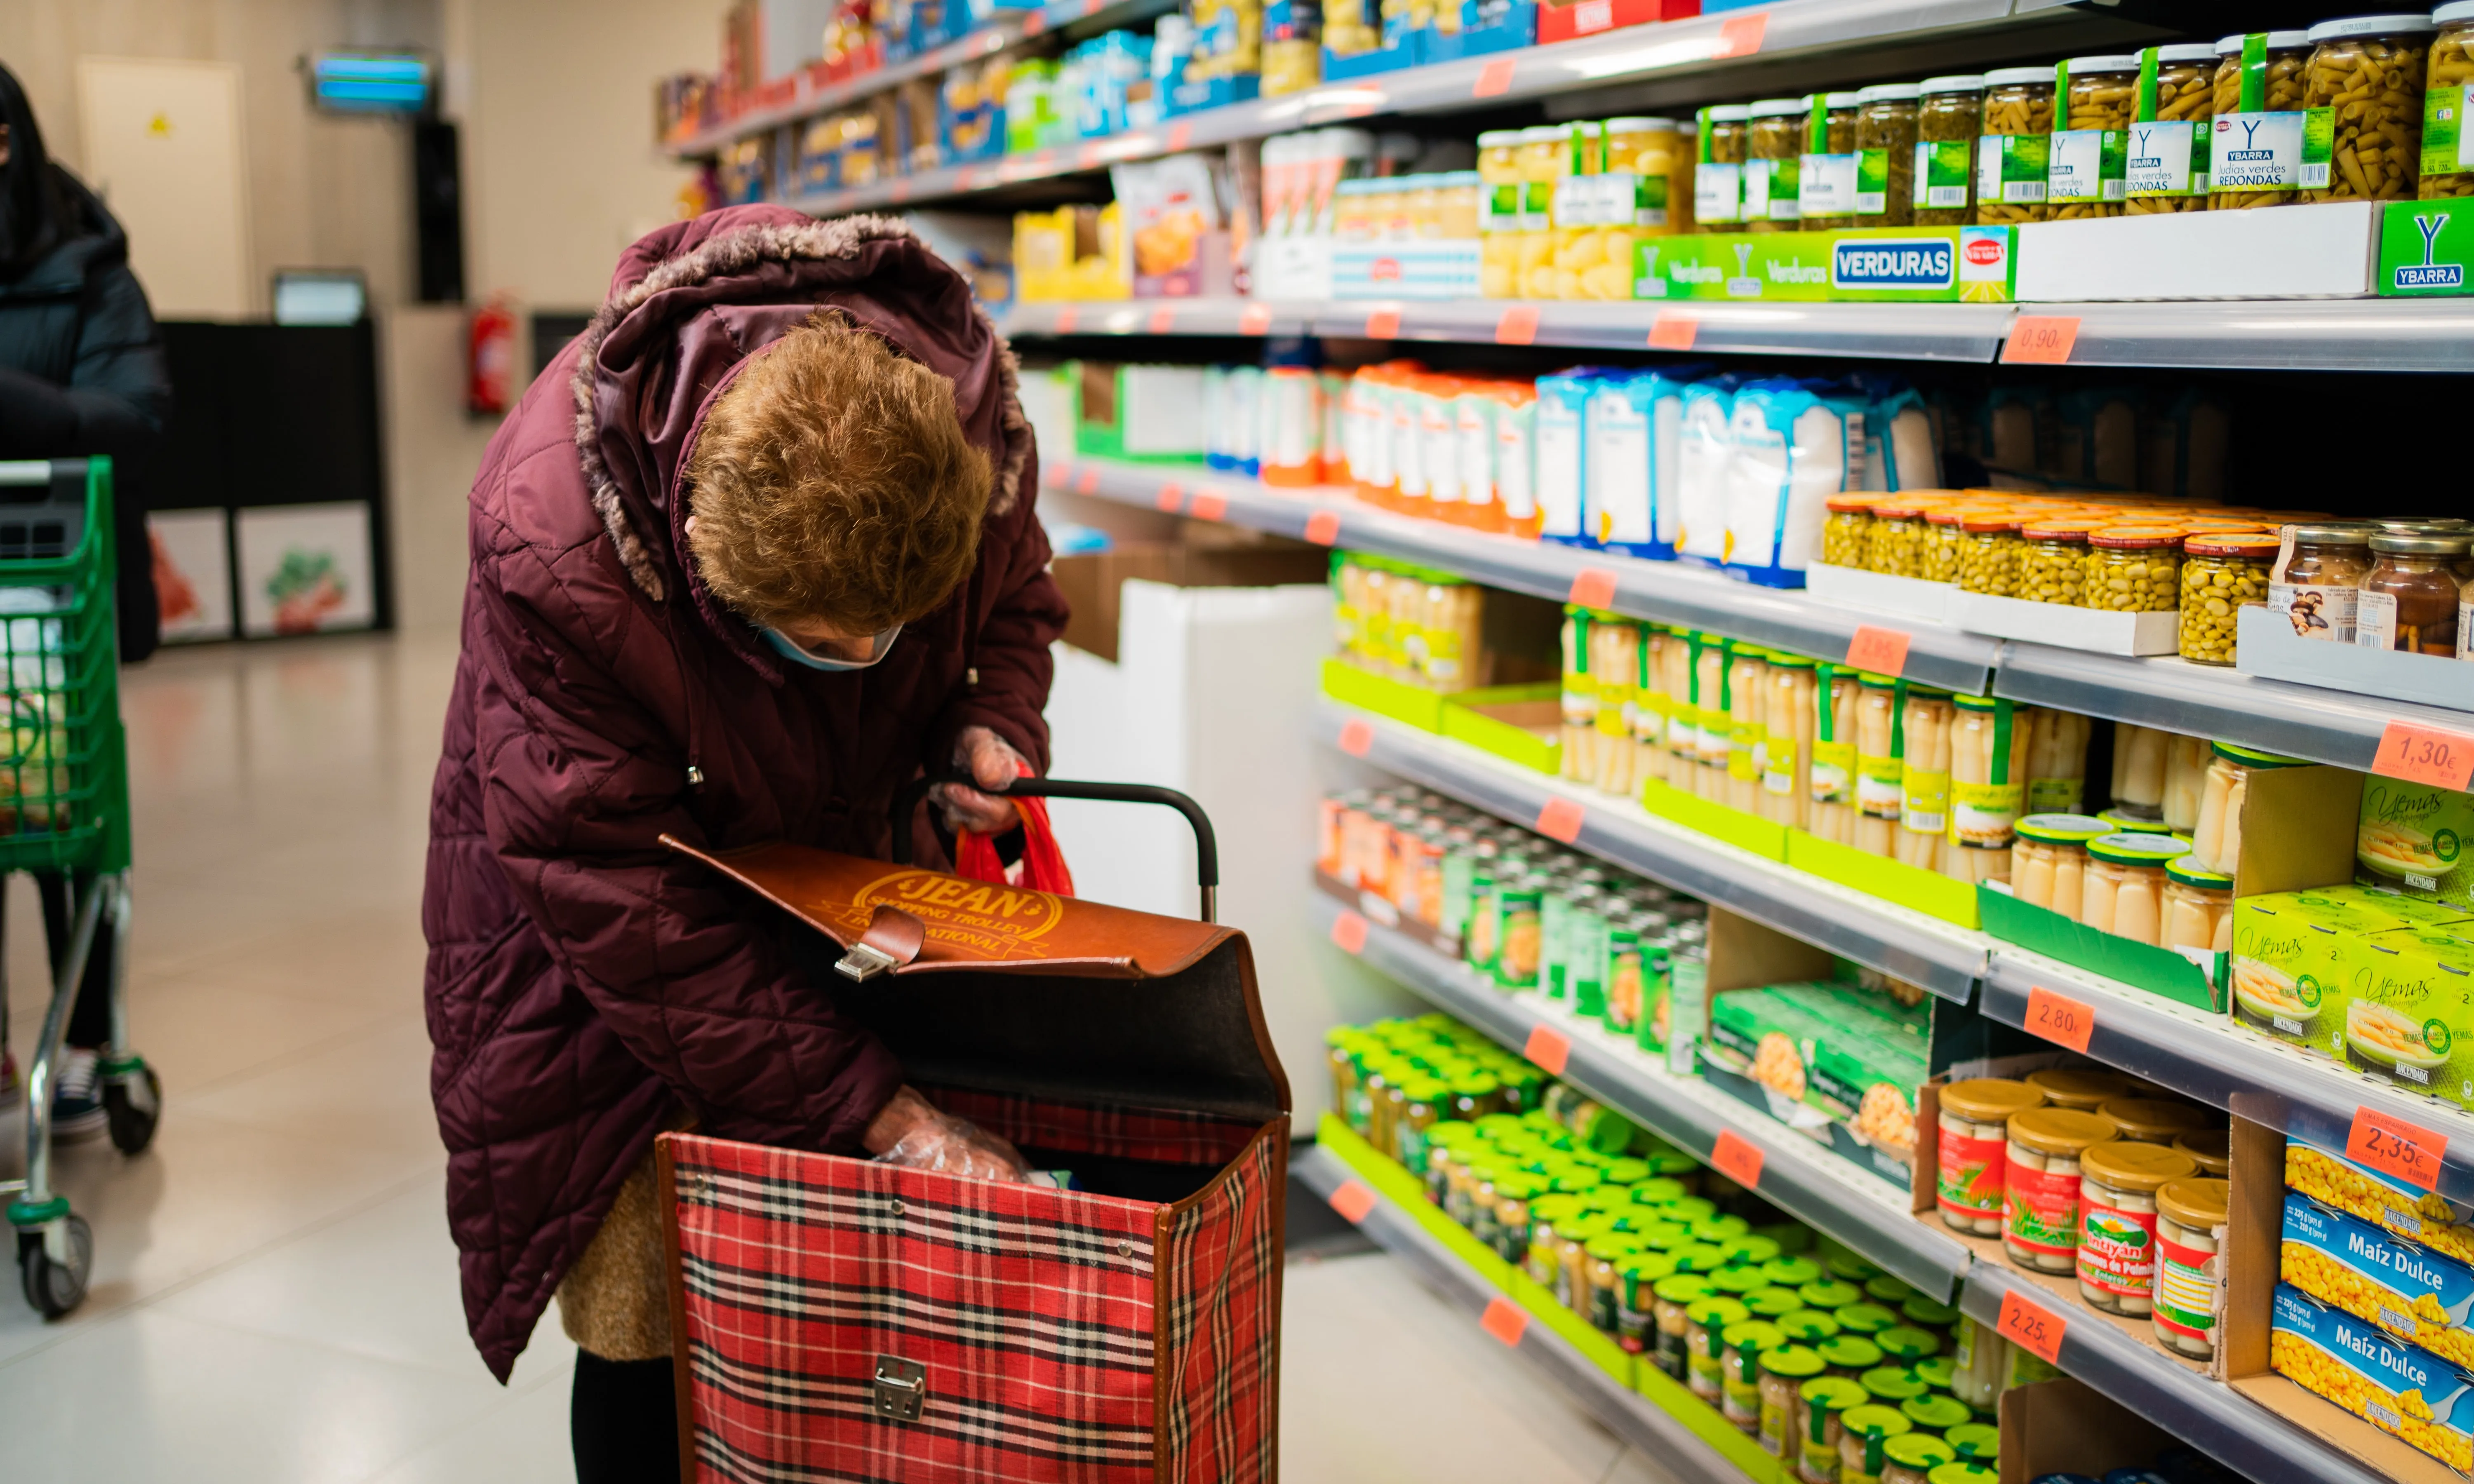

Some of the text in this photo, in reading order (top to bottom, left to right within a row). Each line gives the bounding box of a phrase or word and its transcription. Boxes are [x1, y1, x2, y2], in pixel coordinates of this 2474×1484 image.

[2241, 119, 2263, 149] Y
[2229, 151, 2270, 160] YBARRA
[2142, 168, 2172, 181] verdes
[2218, 161, 2286, 175] Judías verdes
[2219, 174, 2281, 187] REDONDAS
[2415, 214, 2450, 266] Y
[1766, 256, 1827, 284] Verduras
[1838, 251, 1949, 277] VERDURAS
[2399, 269, 2458, 284] YBARRA
[2283, 595, 2291, 603] de
[2400, 737, 2457, 769] 1,30€
[2369, 786, 2447, 826] Yemas
[2405, 872, 2436, 890] HACENDADO
[901, 875, 1035, 918] JEAN
[867, 895, 1029, 935] SHOPPING TROLLEY
[2239, 926, 2307, 967] Yemas
[2331, 951, 2337, 961] 2
[2279, 988, 2296, 997] YEMAS
[2321, 985, 2341, 995] YEMAS
[2355, 967, 2435, 1010] Yemas
[2462, 993, 2469, 1005] 2
[2273, 1016, 2302, 1034] HACENDADO
[2402, 1033, 2422, 1043] YEMAS
[2452, 1030, 2474, 1040] YEMAS
[2396, 1062, 2428, 1082] HACENDADO
[2361, 1111, 2380, 1122] YEMAS
[2380, 1117, 2417, 1135] ESPARRAGO
[2365, 1127, 2424, 1168] 2,35€
[2294, 1207, 2304, 1221] 225
[2384, 1209, 2420, 1233] HACENDADO
[2300, 1221, 2309, 1233] 210
[2348, 1232, 2443, 1291] Maíz Dulce
[2283, 1297, 2293, 1311] 225
[2288, 1311, 2297, 1322] 210
[2380, 1307, 2416, 1334] HACENDADO
[2335, 1324, 2427, 1387] Maíz Dulce
[2366, 1401, 2401, 1429] HACENDADO
